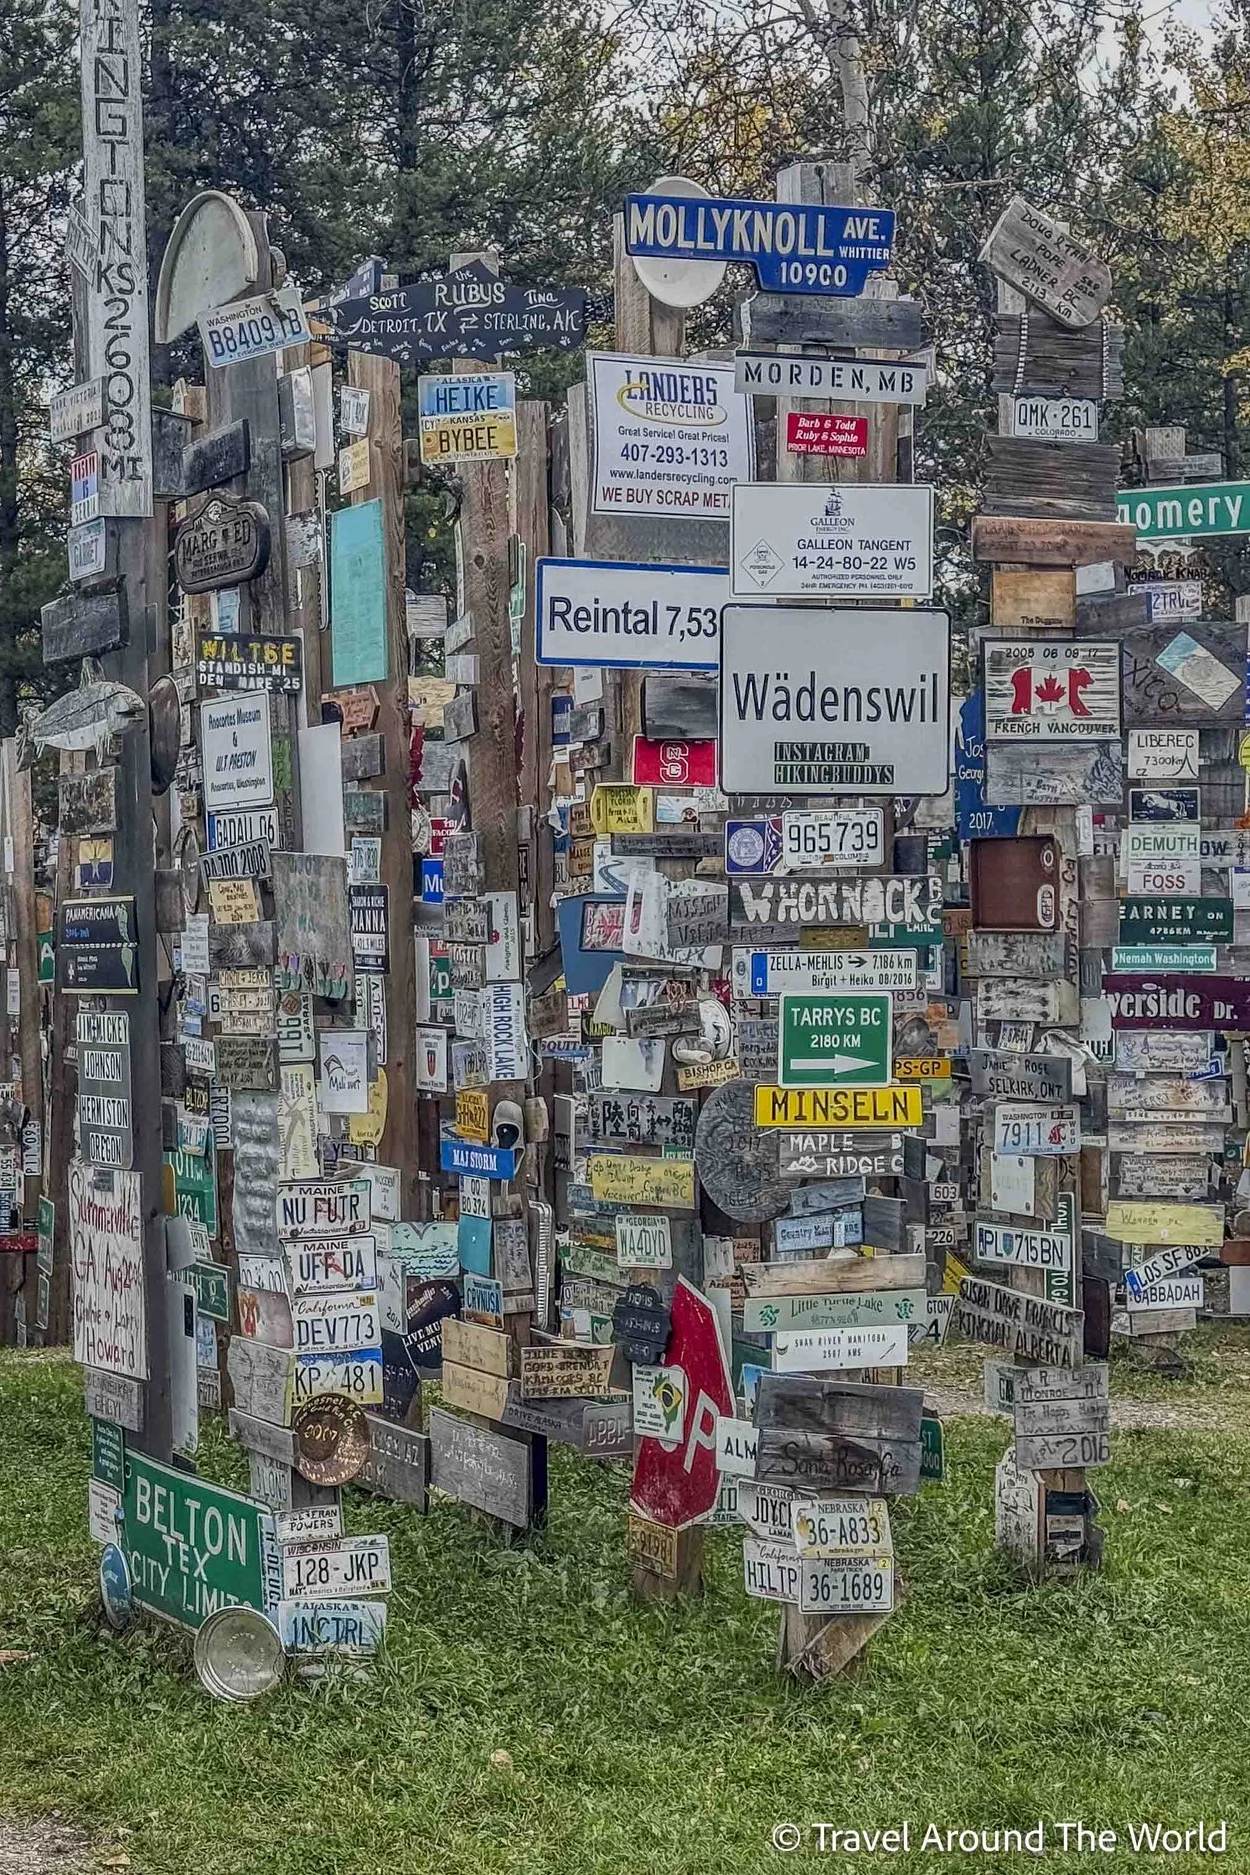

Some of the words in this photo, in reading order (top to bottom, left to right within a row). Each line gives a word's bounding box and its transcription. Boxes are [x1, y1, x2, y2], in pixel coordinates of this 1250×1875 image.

[629, 203, 834, 257] MOLLYKNOLL
[843, 217, 886, 240] AVE.
[839, 246, 890, 261] WHITTIER
[1036, 244, 1066, 270] POPE
[1010, 249, 1058, 290] LADNER
[1061, 288, 1081, 310] BC
[370, 292, 406, 310] SCOTT
[435, 281, 505, 308] RUBYS
[207, 305, 264, 328] WASHINGTON
[360, 319, 422, 335] DETROIT,
[424, 312, 447, 332] TX
[484, 312, 550, 330] STERLING,
[553, 310, 578, 332] AK
[745, 361, 871, 395] MORDEN,
[879, 370, 914, 393] MB
[436, 384, 498, 411] HEIKE
[625, 370, 718, 406] LANDERS
[450, 414, 486, 424] KANSAS
[645, 402, 714, 420] RECYCLING
[798, 417, 820, 429] Barb
[835, 420, 856, 430] Todd
[1034, 428, 1076, 438] COLORADO
[438, 426, 499, 453] BYBEE
[619, 425, 641, 436] Great
[643, 427, 675, 439] Service!
[678, 429, 703, 439] Great
[706, 432, 729, 443] Prices!
[795, 431, 819, 442] Ruby
[829, 433, 858, 443] Sophie
[620, 447, 729, 468] 407-293-1313
[610, 468, 738, 485] www.landersrecycling.com
[602, 487, 624, 503] WE
[626, 489, 654, 504] BUY
[657, 490, 699, 507] SCRAP
[702, 493, 730, 508] MET
[810, 517, 855, 526] GALLEON
[797, 538, 853, 551] GALLEON
[858, 540, 912, 551] TANGENT
[793, 556, 888, 570] 14-24-80-22
[894, 557, 916, 569] W5
[550, 597, 658, 633] Reintal
[199, 660, 265, 677] STANDISH
[733, 672, 939, 723] Wädenswil
[208, 712, 235, 731] Anacortes
[237, 708, 262, 726] Museum
[1137, 734, 1194, 748] LIBEREC
[775, 765, 894, 783] HIKINGBUDDYS
[1136, 768, 1148, 776] CZ
[970, 812, 992, 829] 2017
[788, 820, 879, 853] 965739
[1132, 837, 1196, 852] DEMUTH
[1143, 874, 1186, 889] FOSS
[65, 905, 114, 923] PANAMERICANA
[770, 954, 843, 972] ZELLA-MEHLIS
[897, 955, 913, 969] km
[1118, 952, 1152, 964] Nemah
[1155, 952, 1210, 966] Washington
[812, 973, 837, 989] Birgit
[849, 974, 874, 987] Heiko
[878, 972, 913, 986] 08/2016
[791, 1007, 856, 1028] TARRYS
[860, 1007, 881, 1026] BC
[810, 1034, 840, 1048] 2180
[843, 1034, 861, 1048] KM
[84, 1052, 121, 1081] JOHNSON
[989, 1077, 1038, 1097] SELKIRK,
[81, 1097, 128, 1128] HERMISTON
[771, 1091, 910, 1122] MINSELN
[1002, 1112, 1047, 1120] WASHINGTON
[789, 1133, 854, 1154] MAPLE
[1001, 1122, 1042, 1147] 7911
[90, 1134, 122, 1165] OREGON
[470, 1151, 497, 1171] STORM
[827, 1155, 885, 1174] RIDGE
[299, 1185, 344, 1196] MAINE
[282, 1197, 308, 1225] NU
[303, 1240, 349, 1251] MAINE
[297, 1314, 376, 1347] DEV773
[818, 1502, 865, 1514] NEBRASKA
[135, 1476, 247, 1566] BELTON
[288, 1518, 334, 1531] POWERS
[807, 1517, 882, 1546] 36-A833
[162, 1534, 211, 1582] TEX
[287, 1541, 342, 1556] WISCONSIN
[824, 1558, 870, 1568] NEBRASKA
[809, 1572, 884, 1602] 36-1689
